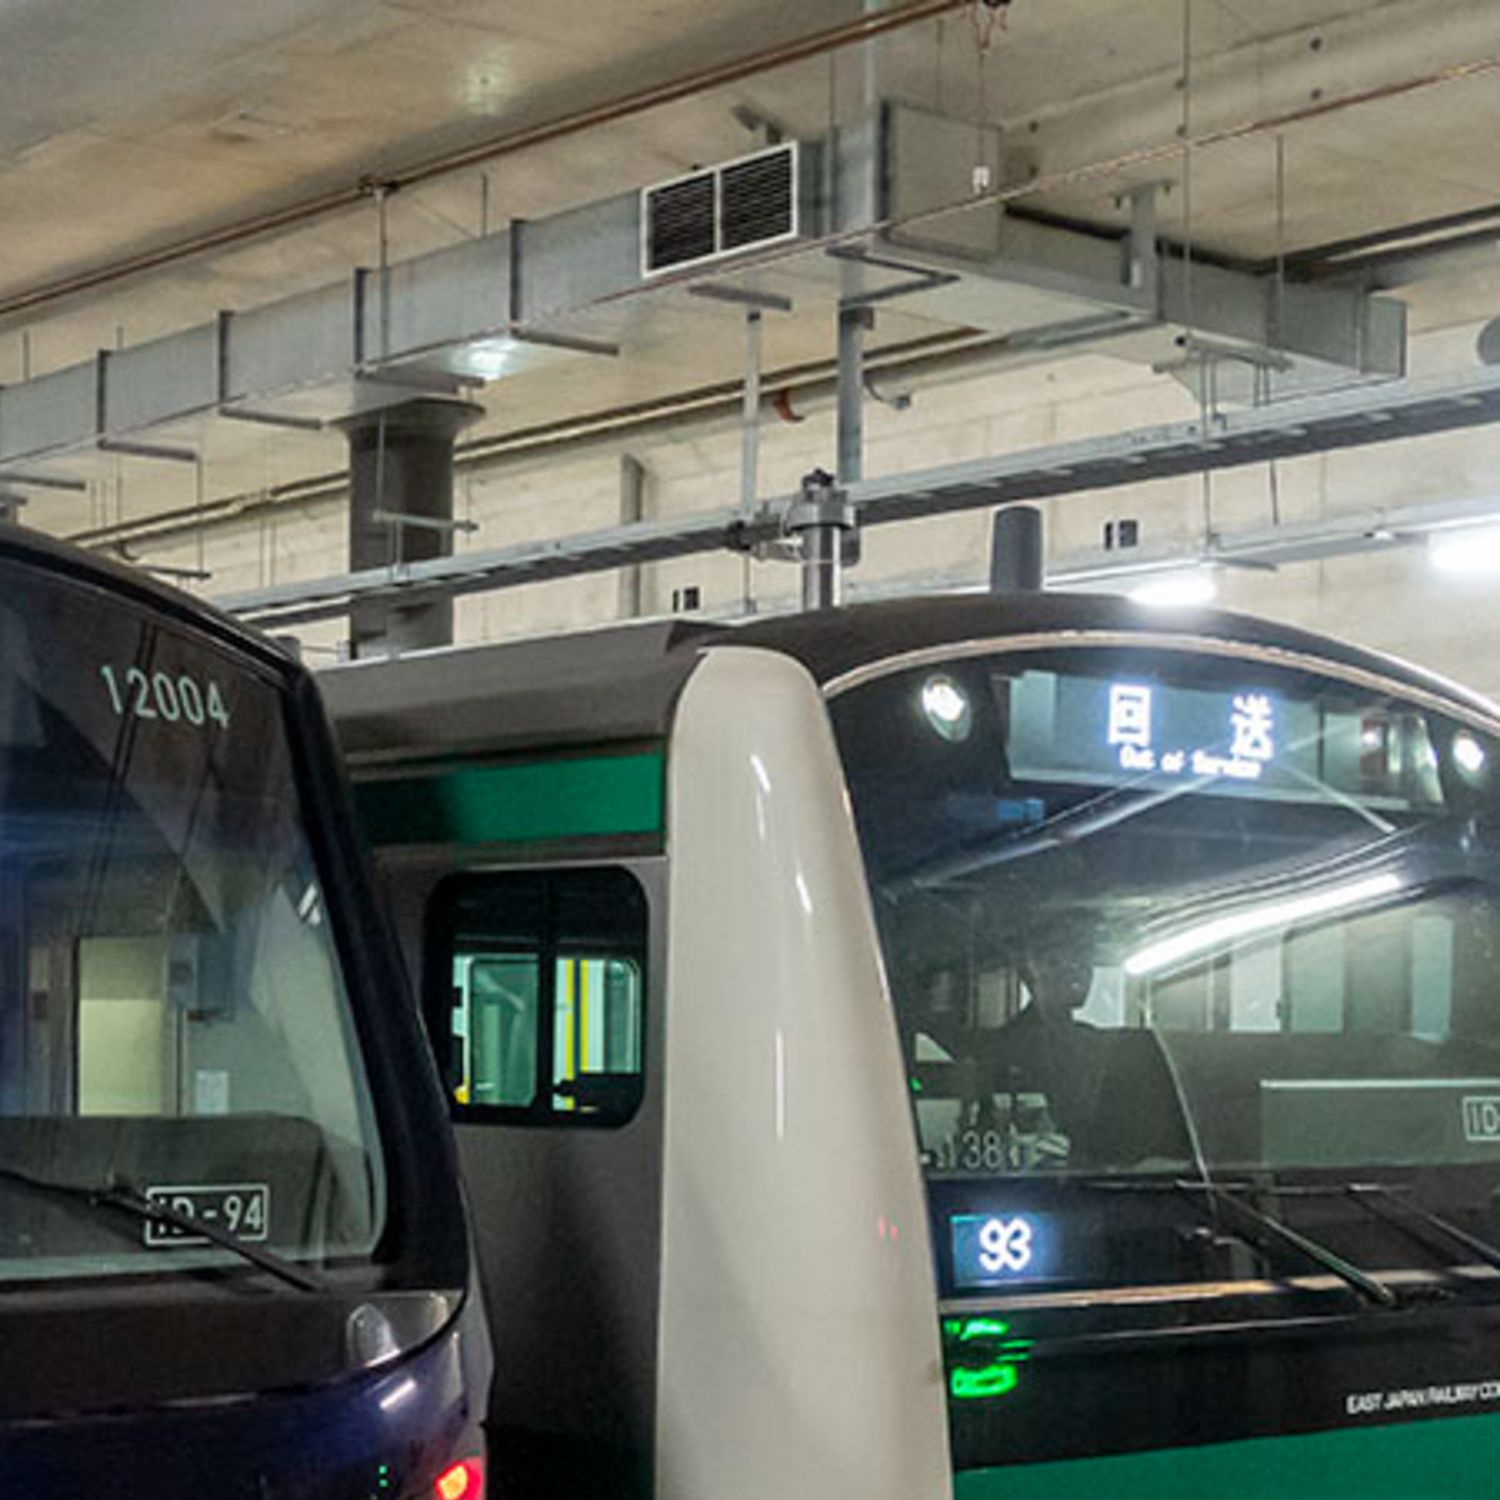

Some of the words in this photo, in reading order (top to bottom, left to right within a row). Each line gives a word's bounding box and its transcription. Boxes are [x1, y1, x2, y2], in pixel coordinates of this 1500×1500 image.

[102, 665, 229, 729] 12004
[978, 1217, 1032, 1272] 93
[1346, 1393, 1383, 1414] EAST
[1480, 1381, 1500, 1400] CO
